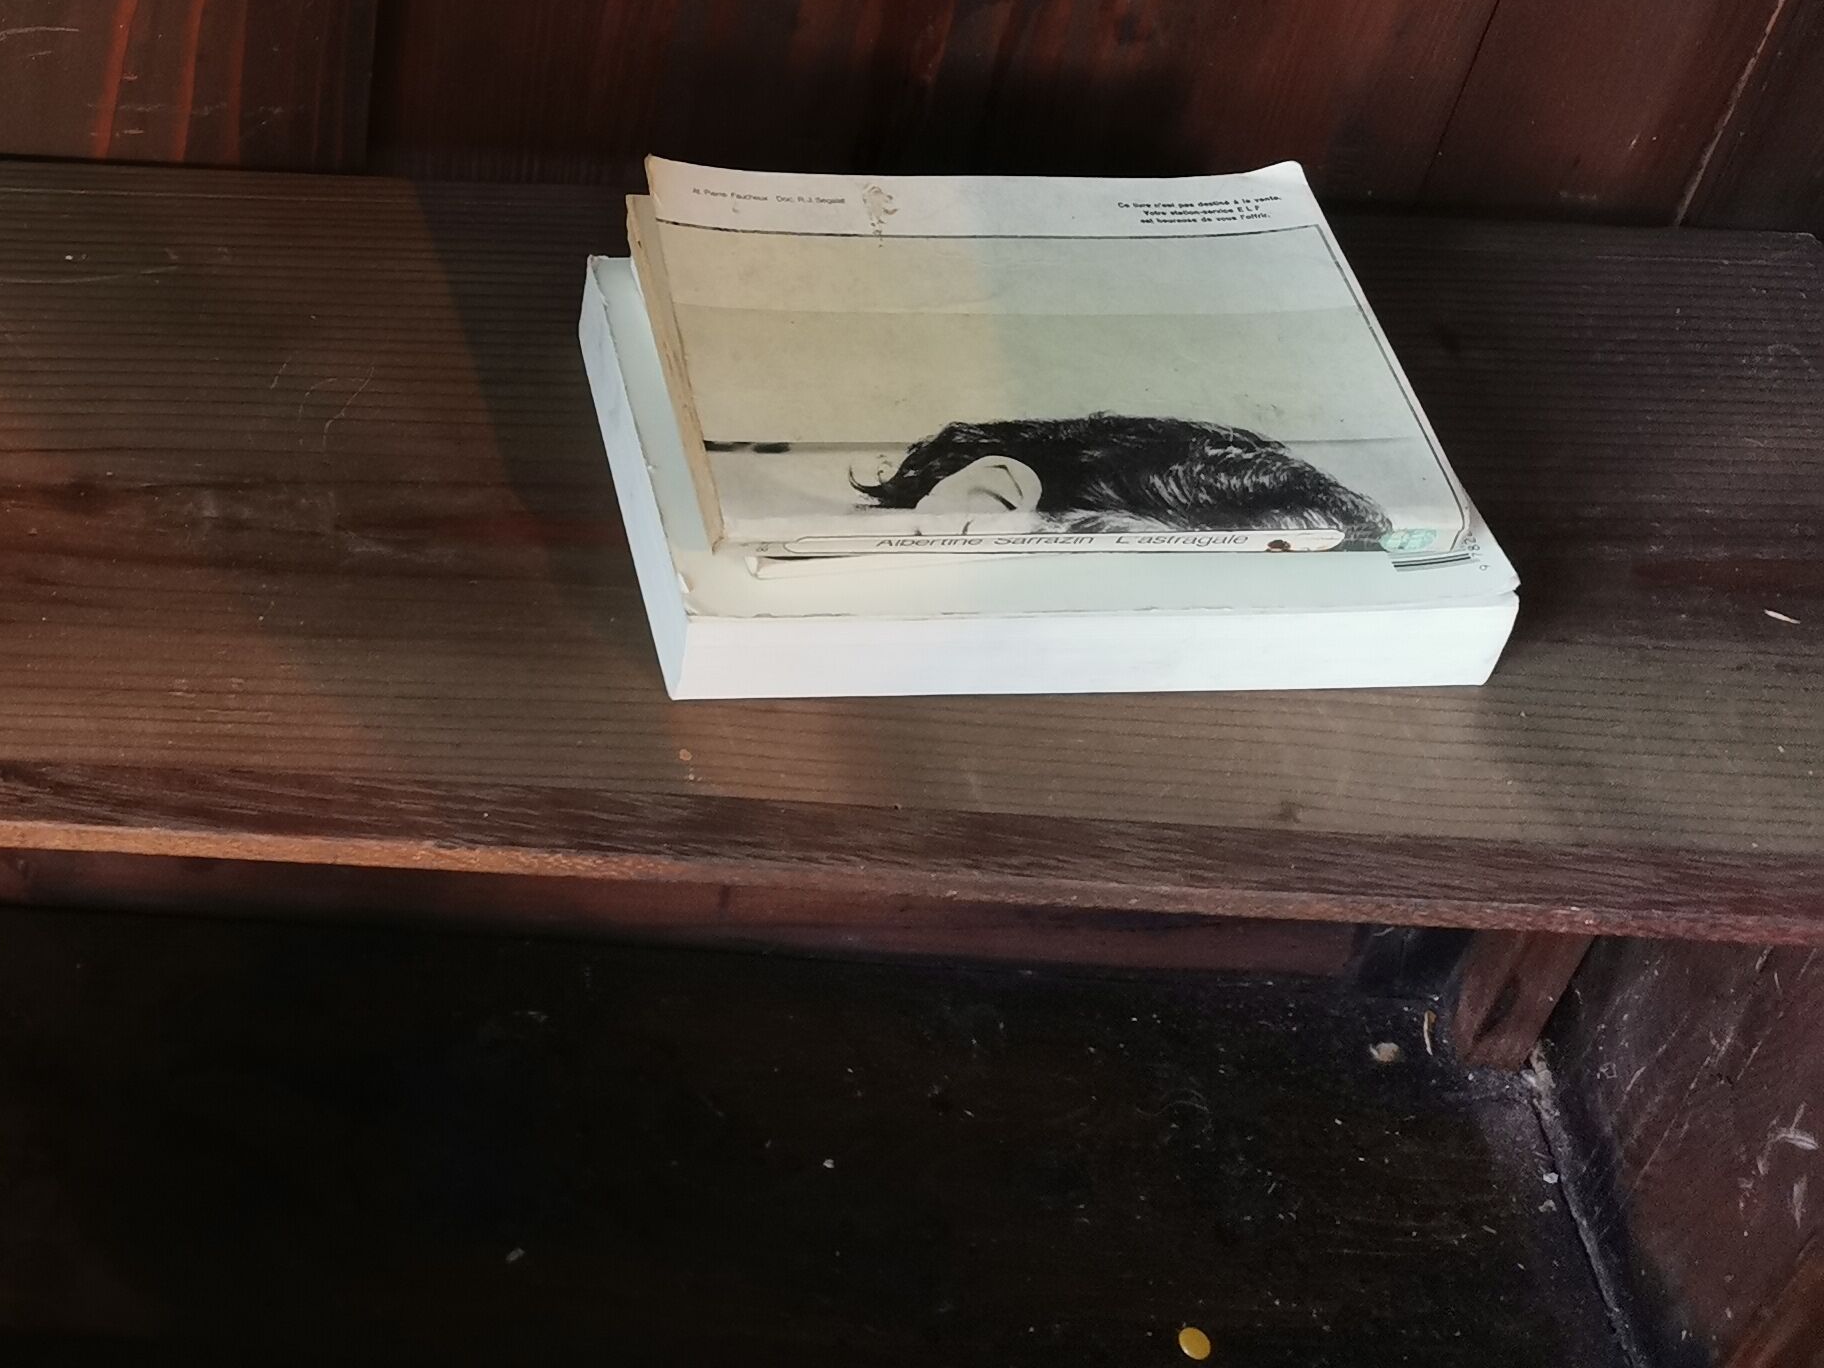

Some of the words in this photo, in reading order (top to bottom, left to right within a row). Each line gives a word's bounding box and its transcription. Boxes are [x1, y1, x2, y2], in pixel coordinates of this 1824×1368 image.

[875, 536, 983, 547] Albertine
[994, 534, 1095, 546] Sarrazin
[1114, 533, 1250, 548] L'astragale
